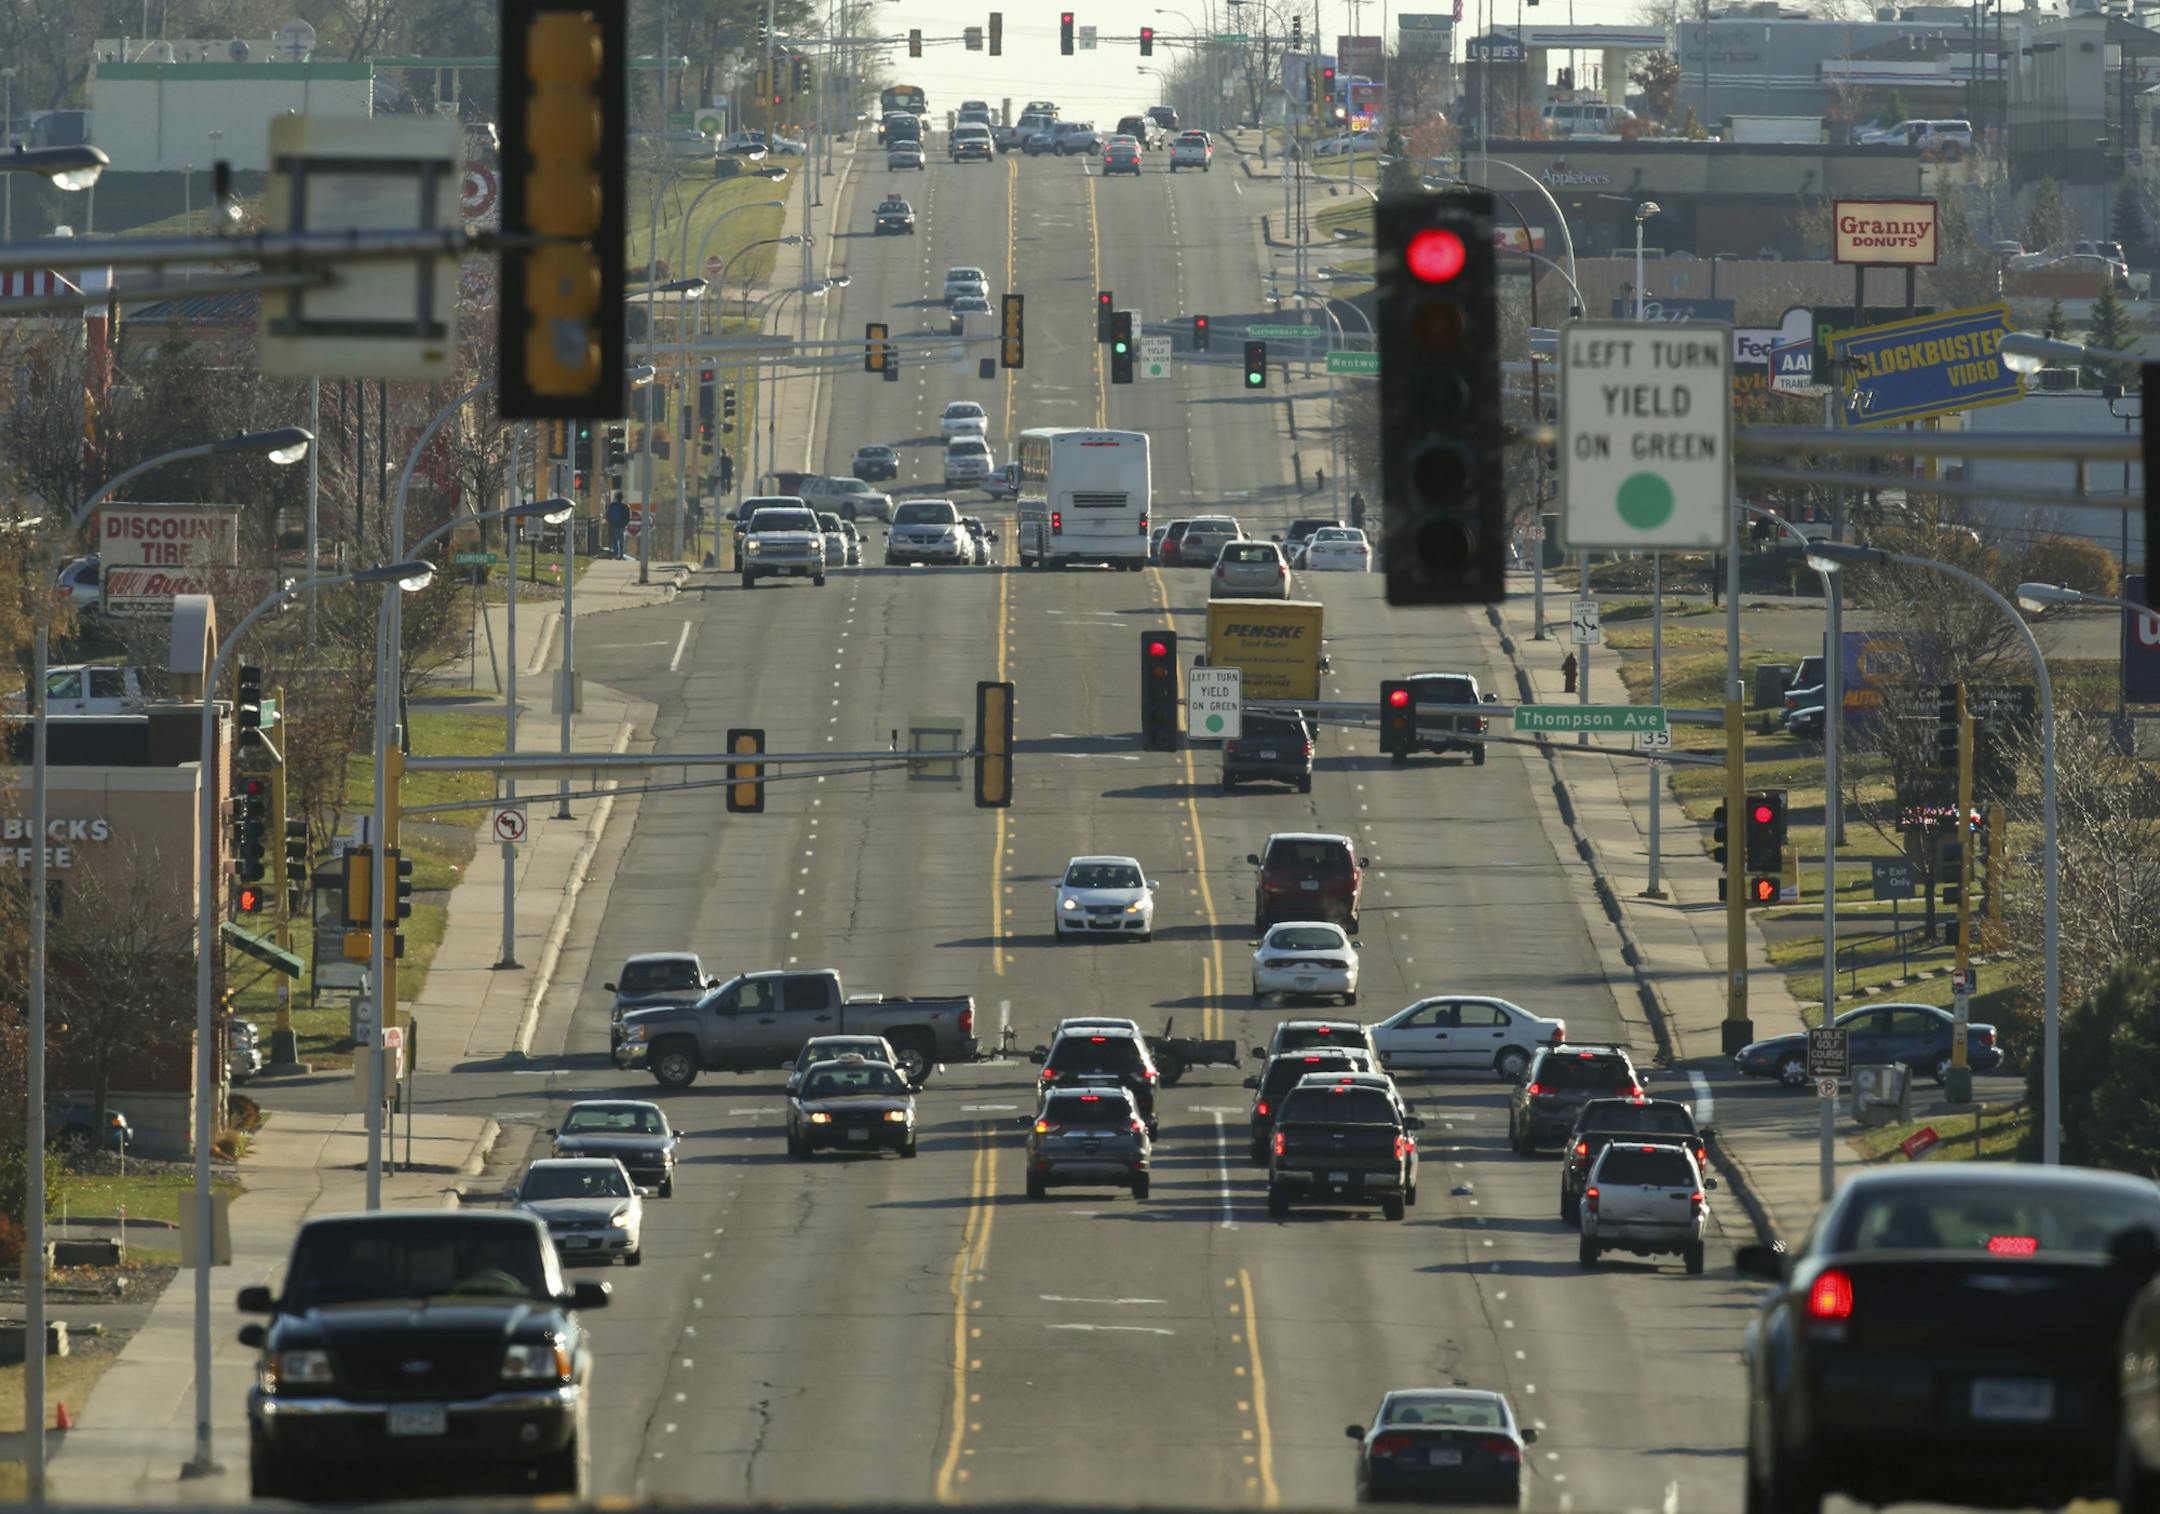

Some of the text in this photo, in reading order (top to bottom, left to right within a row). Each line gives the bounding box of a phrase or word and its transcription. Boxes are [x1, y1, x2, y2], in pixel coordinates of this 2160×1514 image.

[1840, 216, 1932, 239] Granny
[1852, 237, 1918, 248] DONUTS
[1572, 340, 1719, 368] LEFT TURN
[1947, 359, 2000, 388] VIDEO
[1602, 384, 1692, 418] YIELD
[1574, 432, 1716, 461] ON GREEN
[107, 517, 230, 540] DISCOUNT
[141, 541, 194, 564] TIRE
[1224, 624, 1305, 639] PENSKE
[1192, 673, 1211, 682] LEFT
[1217, 673, 1238, 682] TURN
[1201, 687, 1230, 697] YIELD
[1192, 702, 1237, 711] ON GREEN
[1522, 712, 1658, 728] Thompson Ave
[1643, 731, 1669, 745] 35
[1889, 867, 1907, 875] Exit
[1890, 878, 1911, 887] Only
[1812, 1031, 1844, 1039] PUBLIC
[1817, 1041, 1840, 1049] GOLF
[1811, 1050, 1845, 1059] COURSE
